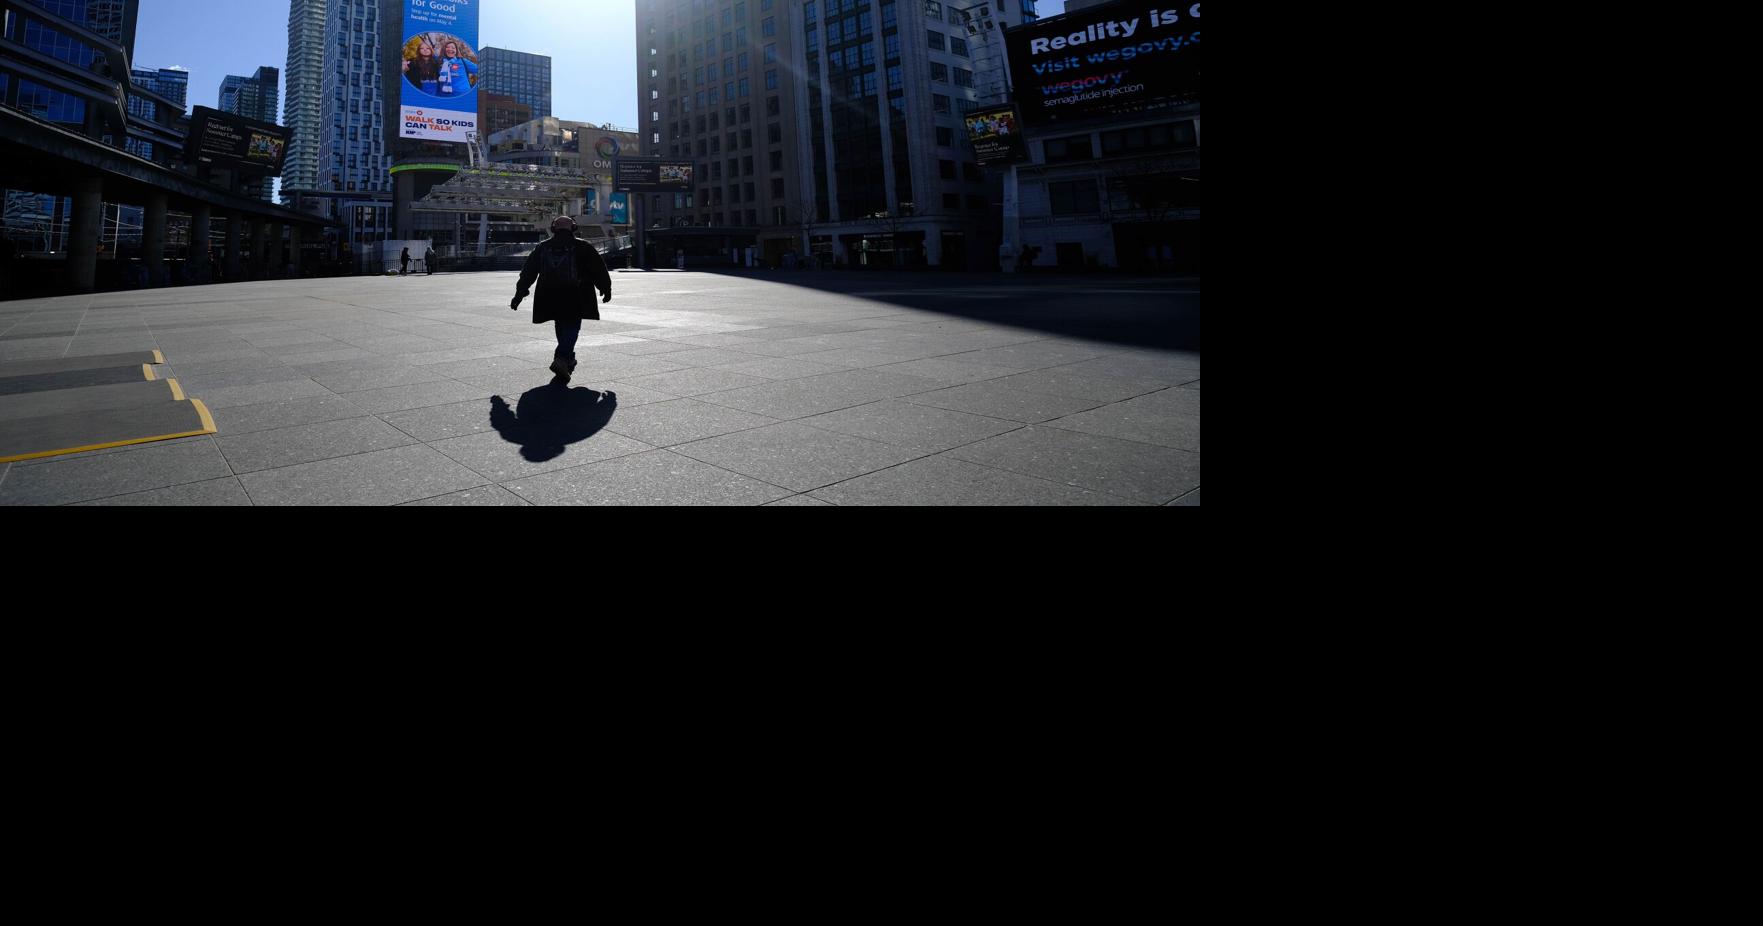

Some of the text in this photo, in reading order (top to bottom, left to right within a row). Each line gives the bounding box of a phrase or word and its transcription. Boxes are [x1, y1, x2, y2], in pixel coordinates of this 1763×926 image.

[429, 1, 456, 13] Good
[1030, 17, 1140, 56] Reality
[1149, 9, 1179, 28] is
[1031, 56, 1081, 76] Visit
[1041, 71, 1123, 96] wegovy
[1043, 82, 1144, 107] semaglutide injection
[405, 115, 434, 124] WALK
[451, 120, 474, 128] KIDS
[429, 124, 453, 132] TALK
